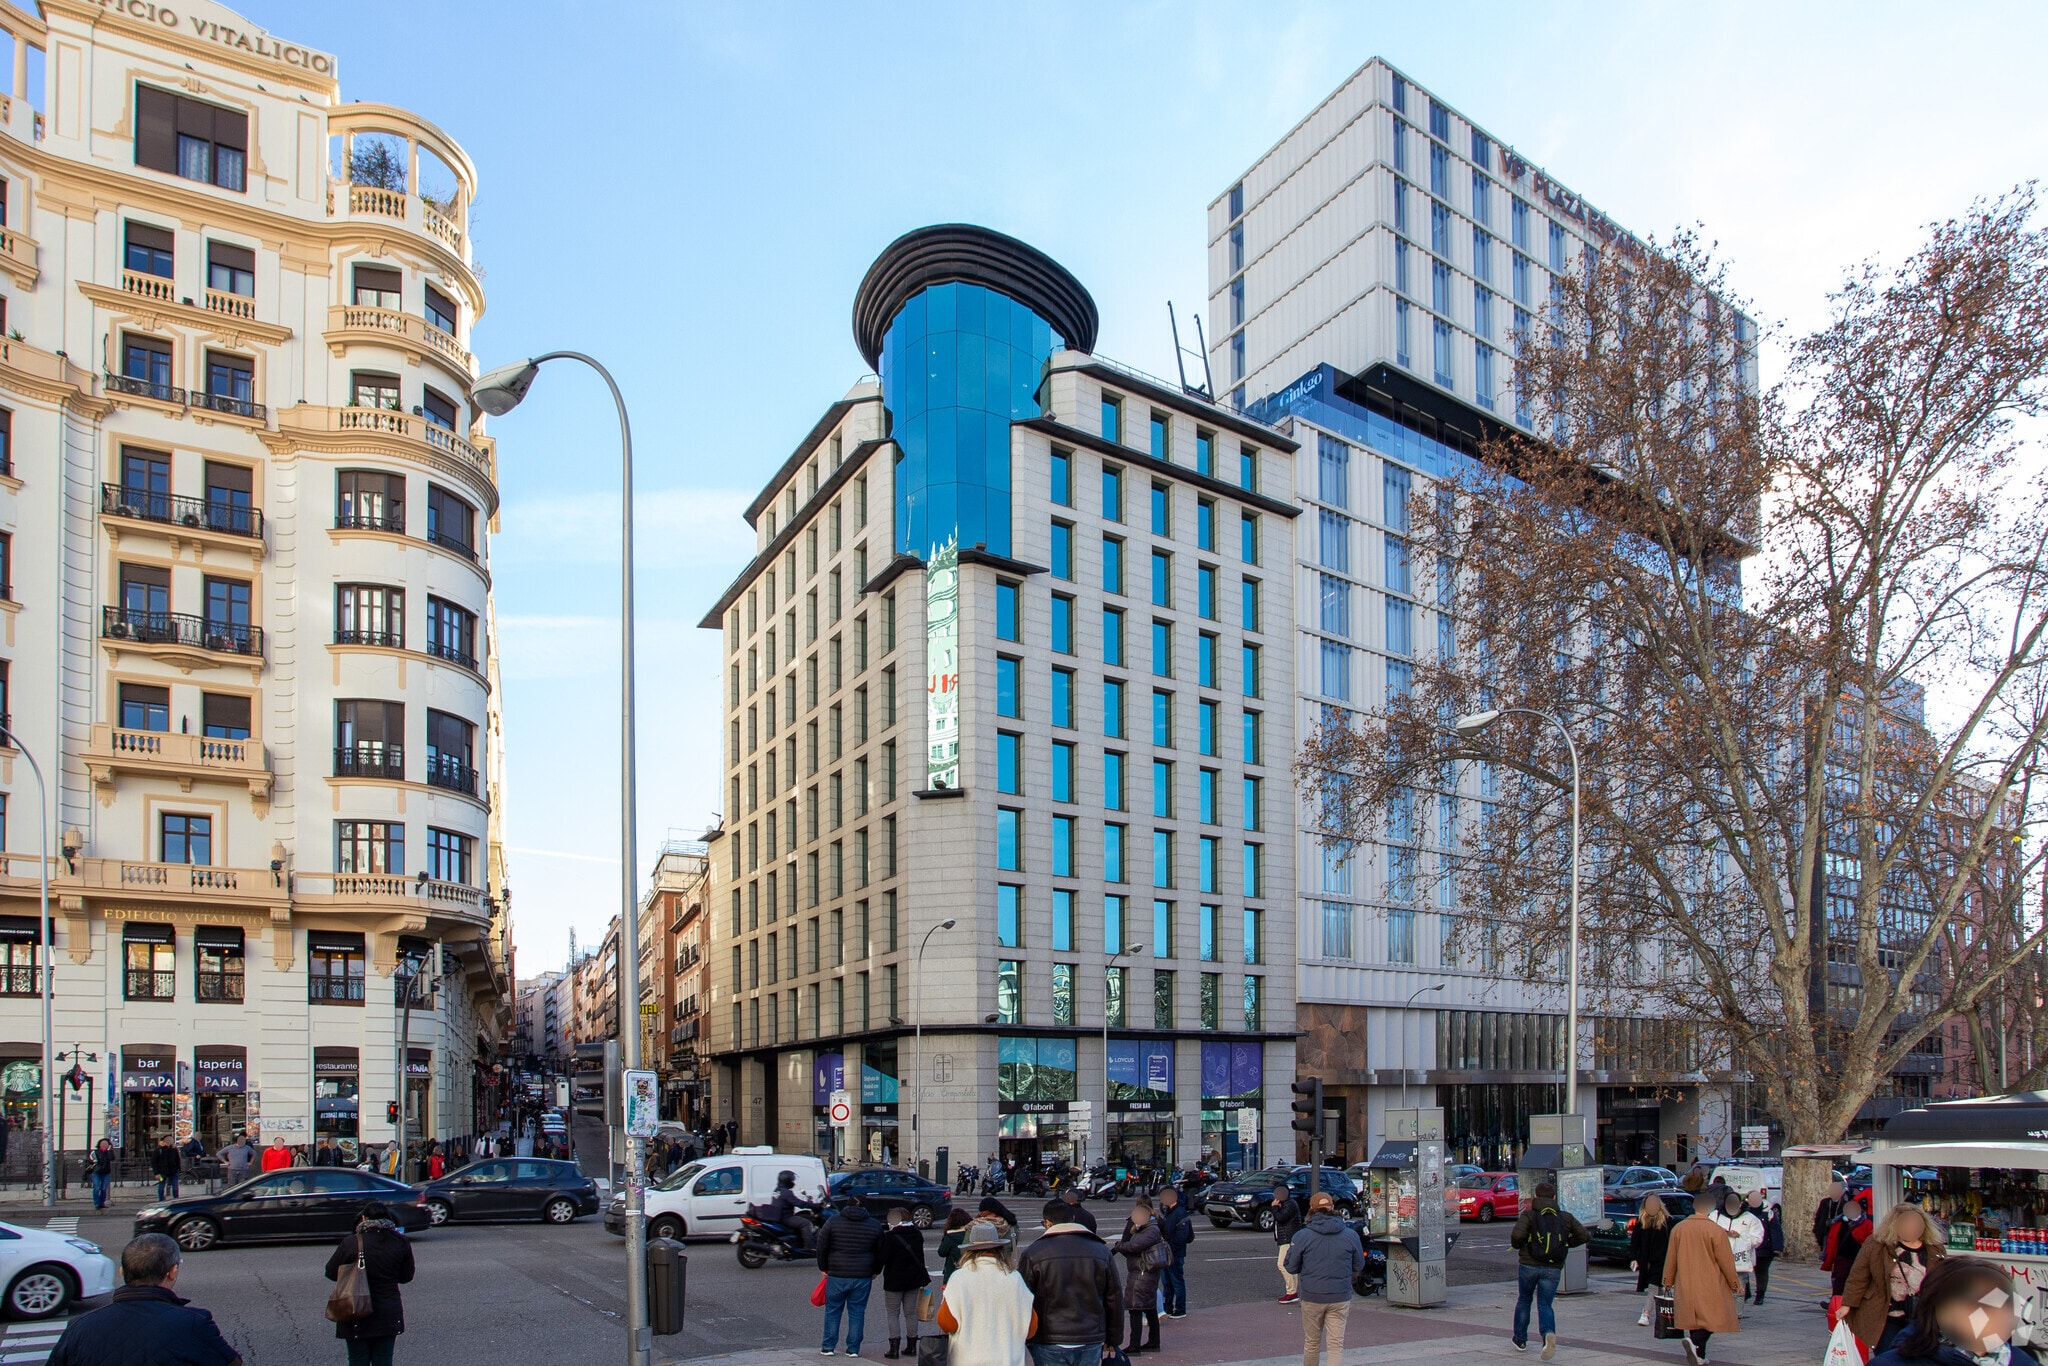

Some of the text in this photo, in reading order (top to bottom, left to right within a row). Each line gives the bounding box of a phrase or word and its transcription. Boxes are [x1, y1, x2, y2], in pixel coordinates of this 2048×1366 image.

[189, 16, 330, 73] VITALICIO
[1498, 147, 1526, 179] VP
[1533, 171, 1587, 226] PLAZA
[1279, 372, 1323, 408] Ginkgo
[103, 908, 264, 925] EDIFICIO VITALICIO
[138, 1059, 161, 1068] bar
[199, 1059, 243, 1071] tapería
[753, 1097, 762, 1105] 47
[912, 1088, 935, 1102] Eificio
[1030, 1103, 1054, 1111] faborit
[1726, 1174, 1754, 1184] ZUHAUSE
